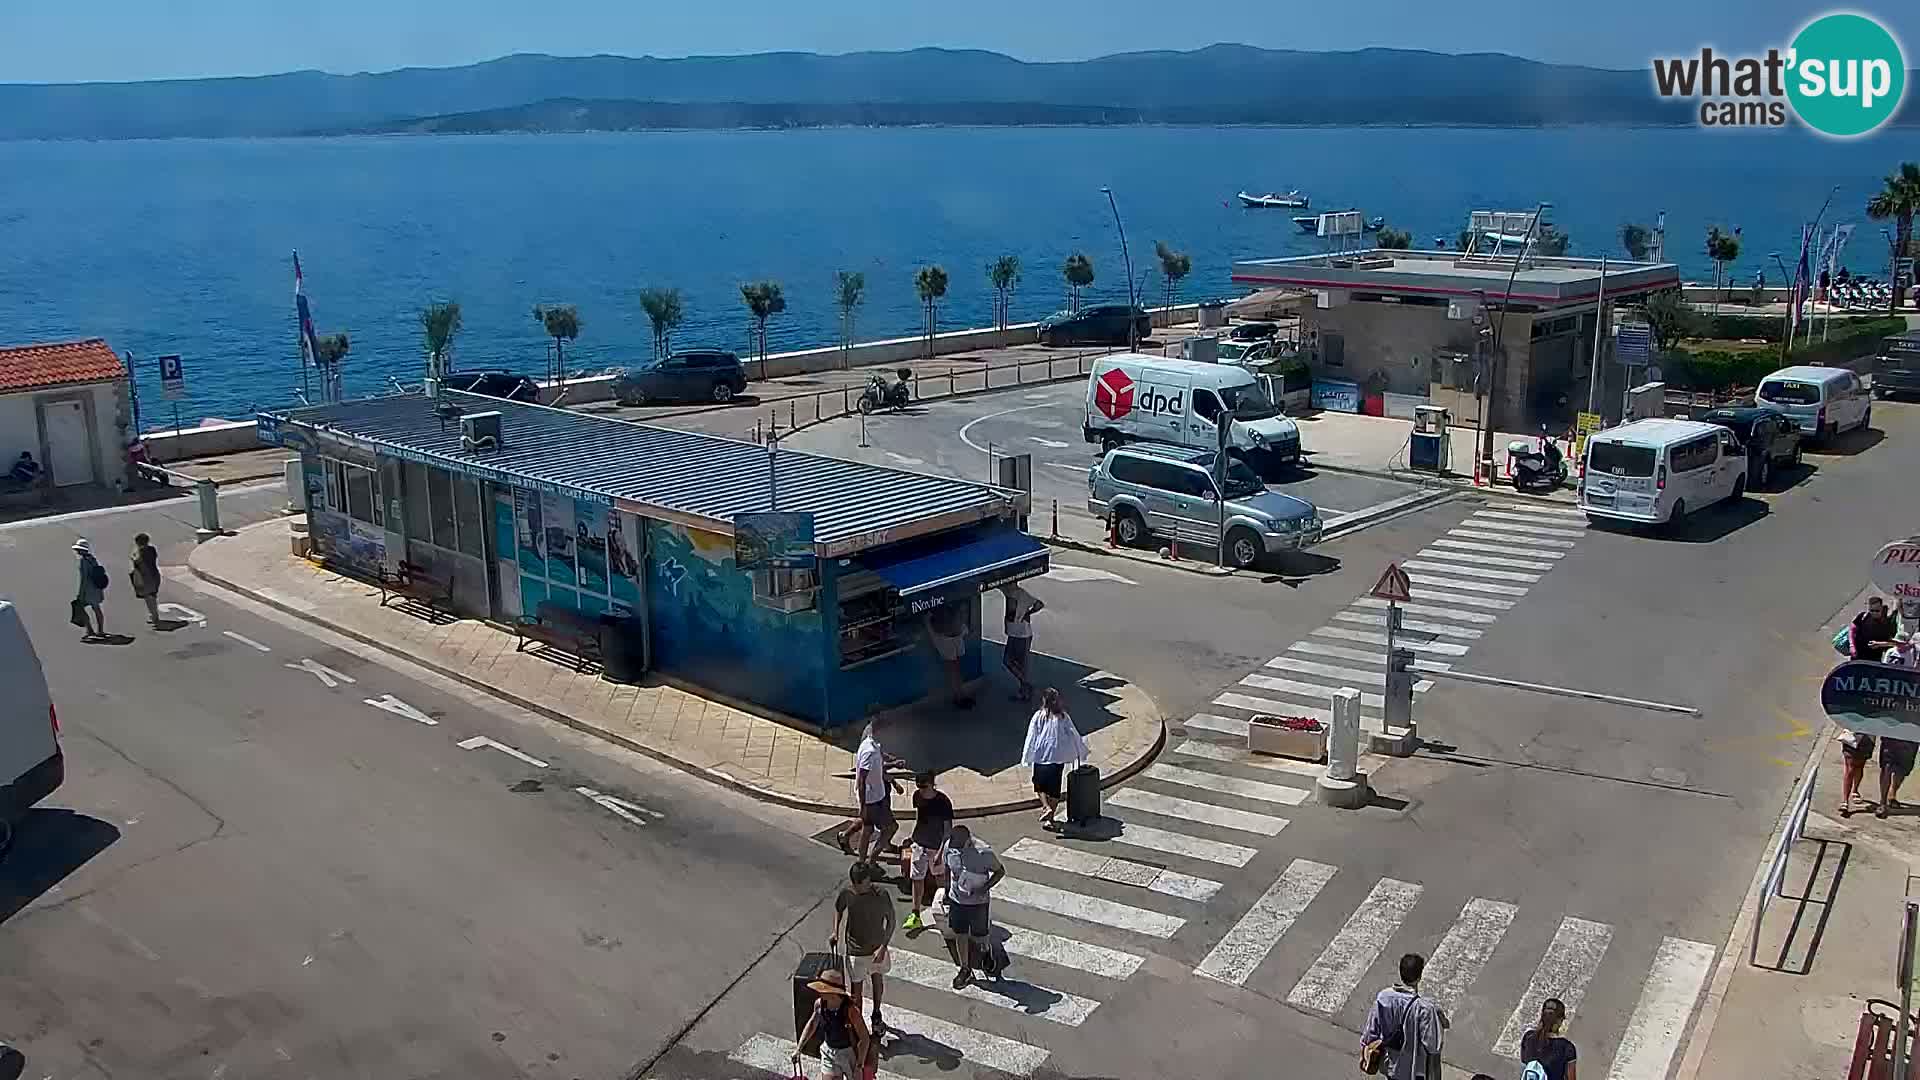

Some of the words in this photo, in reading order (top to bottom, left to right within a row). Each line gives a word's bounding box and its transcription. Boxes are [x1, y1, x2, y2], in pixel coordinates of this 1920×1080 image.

[164, 357, 177, 377] P
[1783, 381, 1800, 389] TAXI
[1140, 386, 1183, 417] dpd
[523, 478, 555, 493] STATION
[583, 493, 611, 506] OFFICE
[911, 595, 945, 614] iNovine
